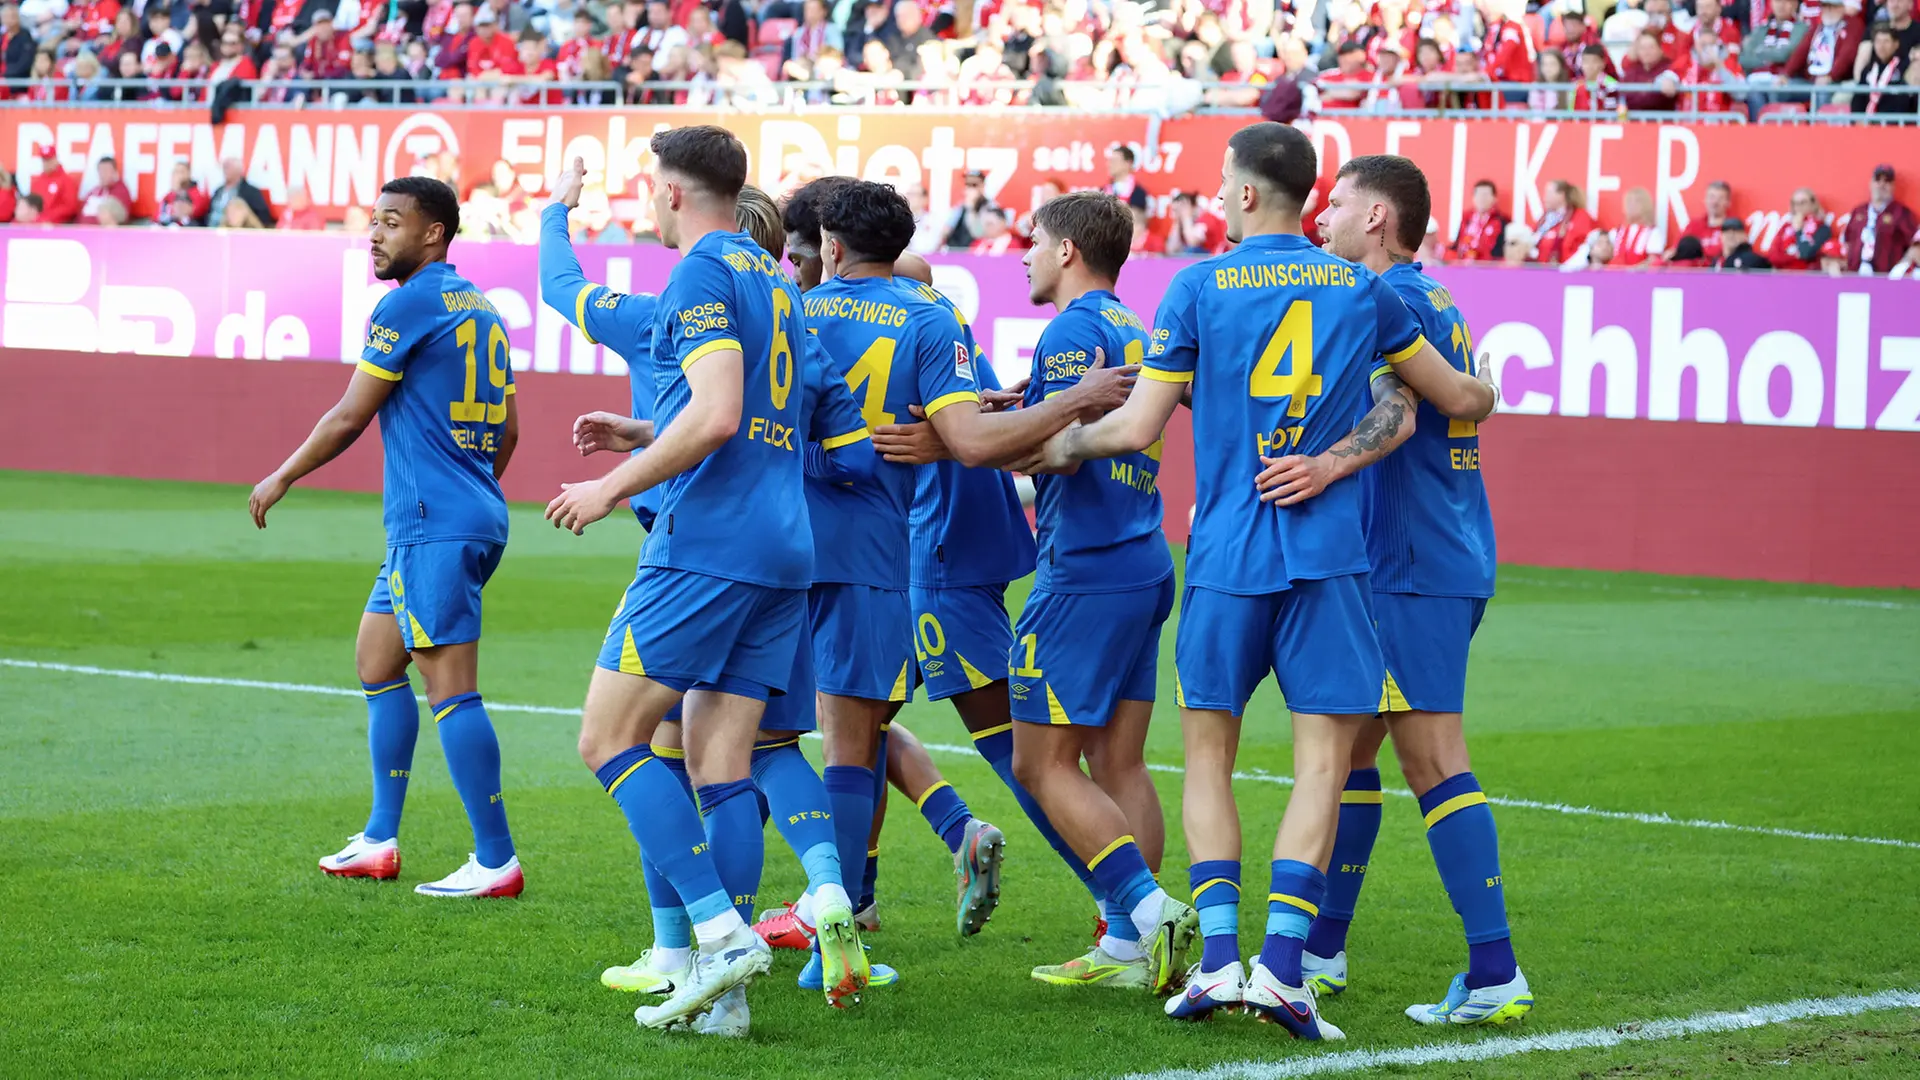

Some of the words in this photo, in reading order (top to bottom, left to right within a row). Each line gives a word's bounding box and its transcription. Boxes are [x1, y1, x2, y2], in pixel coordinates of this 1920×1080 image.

[1215, 263, 1356, 290] BRAUNSCHWEIG
[678, 301, 726, 324] lease
[803, 296, 908, 328] AUNSCHWEIG
[769, 287, 793, 411] 6
[1250, 300, 1323, 418] 4
[1476, 285, 1920, 431] chholz
[450, 318, 510, 425] 19
[748, 417, 796, 451] FLICK
[390, 769, 411, 778] BTS
[1340, 863, 1368, 875] BTS
[734, 894, 755, 906] BTS
